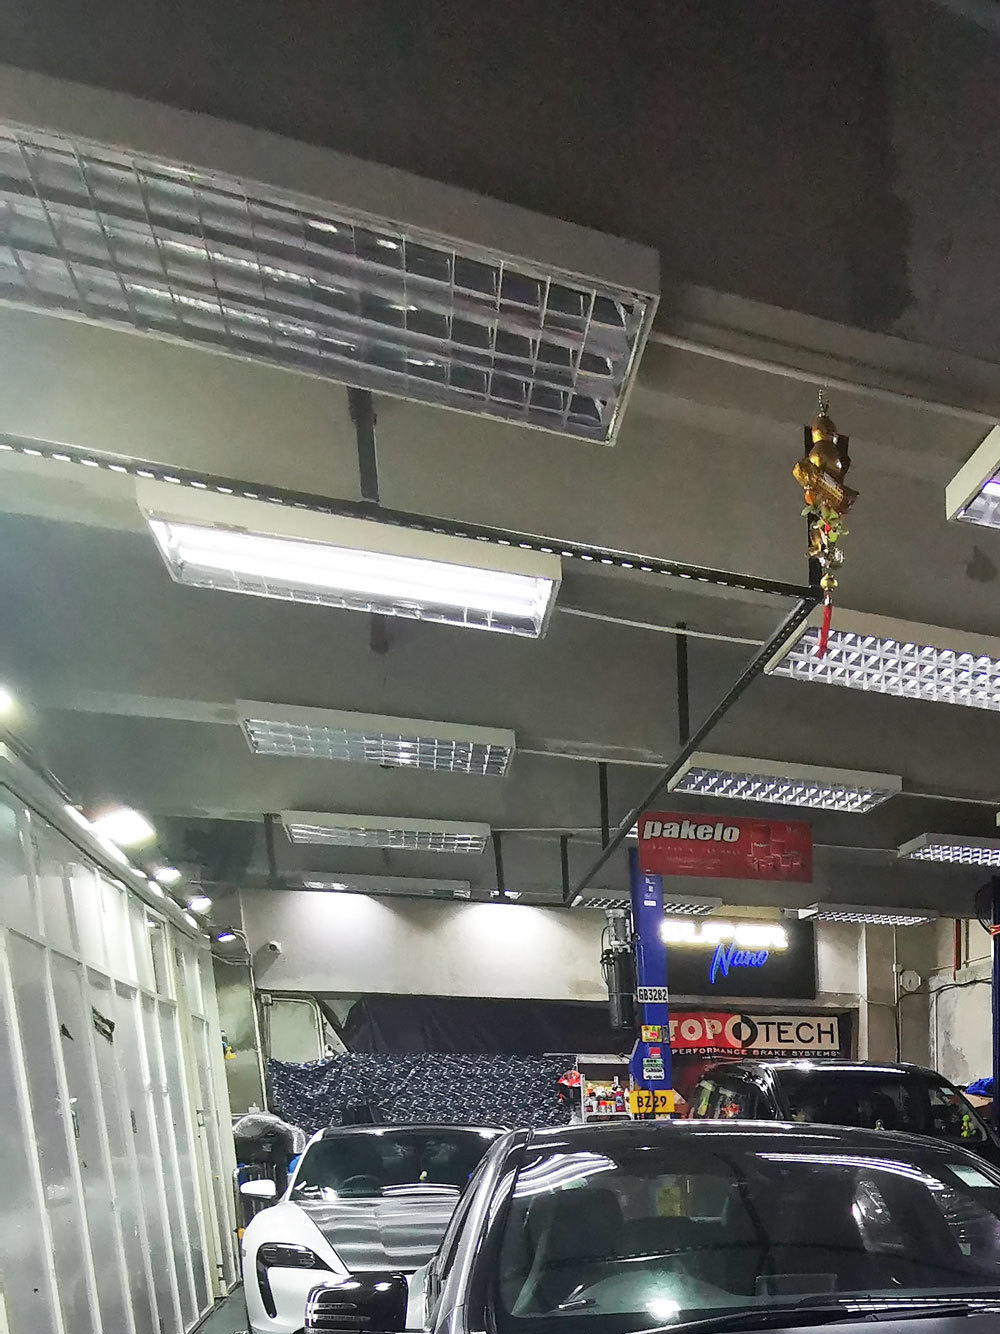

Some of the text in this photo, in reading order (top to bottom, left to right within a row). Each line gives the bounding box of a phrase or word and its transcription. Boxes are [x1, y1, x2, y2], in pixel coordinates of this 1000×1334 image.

[643, 819, 740, 843] pakelo
[709, 942, 769, 984] Nano
[638, 988, 668, 1001] GB3282
[757, 1021, 834, 1044] TECH
[671, 1046, 748, 1056] PERFORMANCE
[753, 1049, 787, 1057] BRAKE
